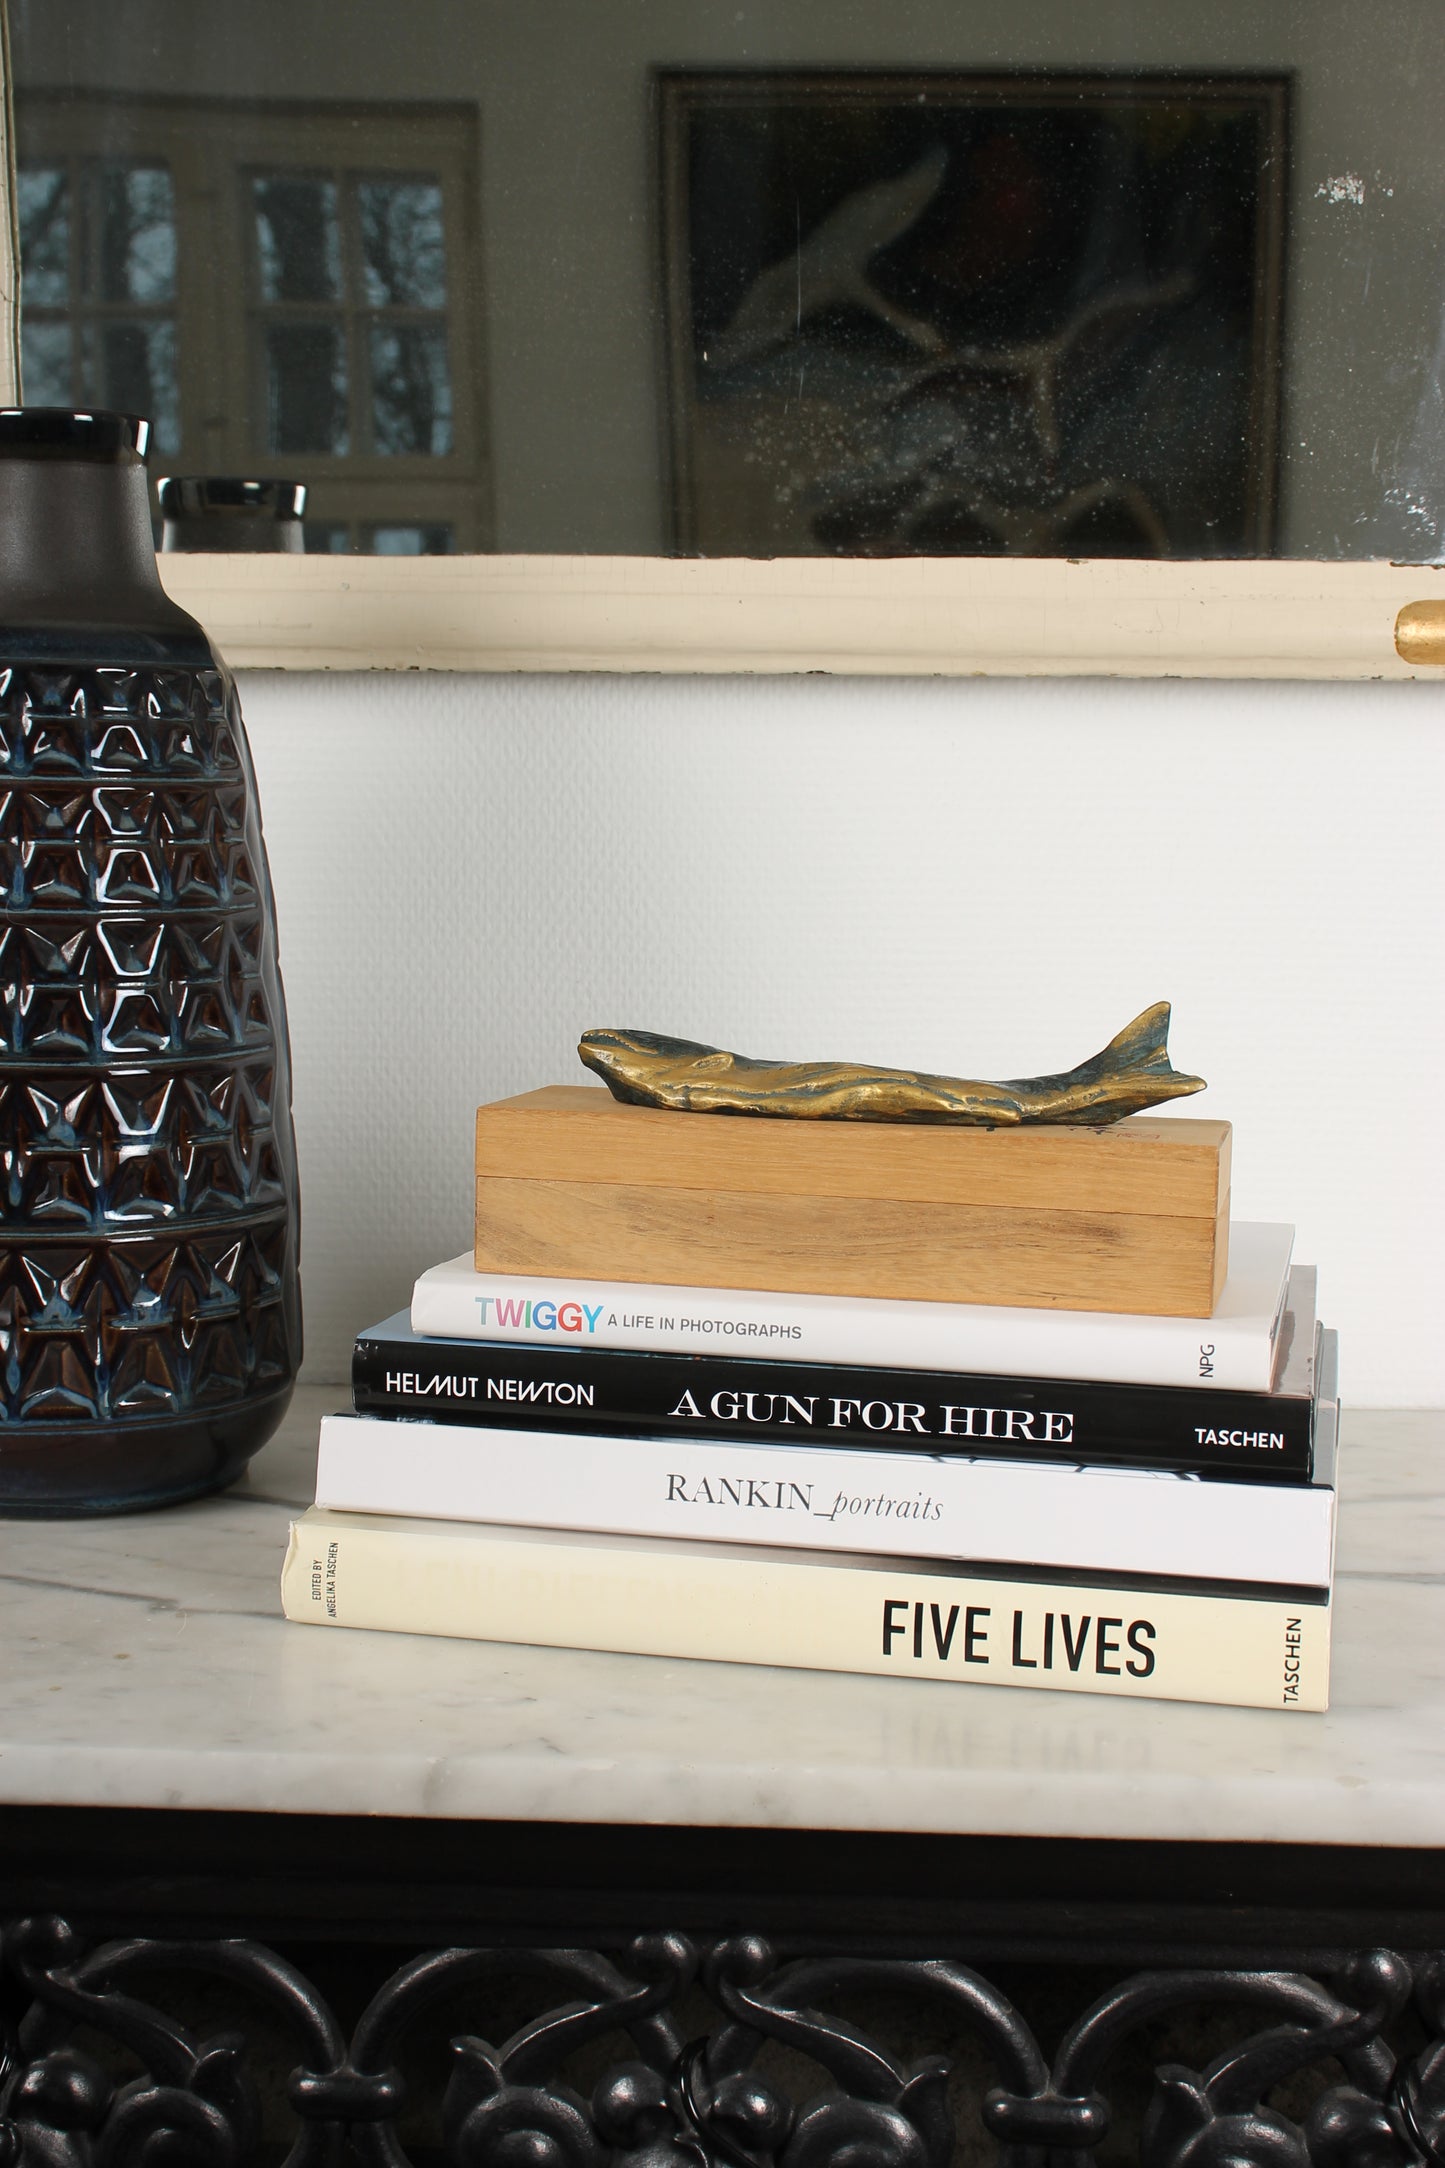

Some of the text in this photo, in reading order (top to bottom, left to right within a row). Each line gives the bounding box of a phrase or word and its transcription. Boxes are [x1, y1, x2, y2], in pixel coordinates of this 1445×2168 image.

[475, 1297, 802, 1339] TWIGGY A LIFE IN PHOTOGRAPHS
[1199, 1344, 1215, 1378] NPG
[386, 1372, 594, 1406] HELMUT NEWTON
[667, 1389, 1074, 1443] A GUN FOR HIRE
[1195, 1428, 1284, 1449] TASCHEN
[312, 1560, 322, 1600] EDITED BY
[326, 1542, 338, 1618] ANGELIKA TASCHEN
[882, 1600, 990, 1664] FIVE
[1012, 1610, 1157, 1678] LIVES
[1284, 1618, 1302, 1703] TASCHEN
